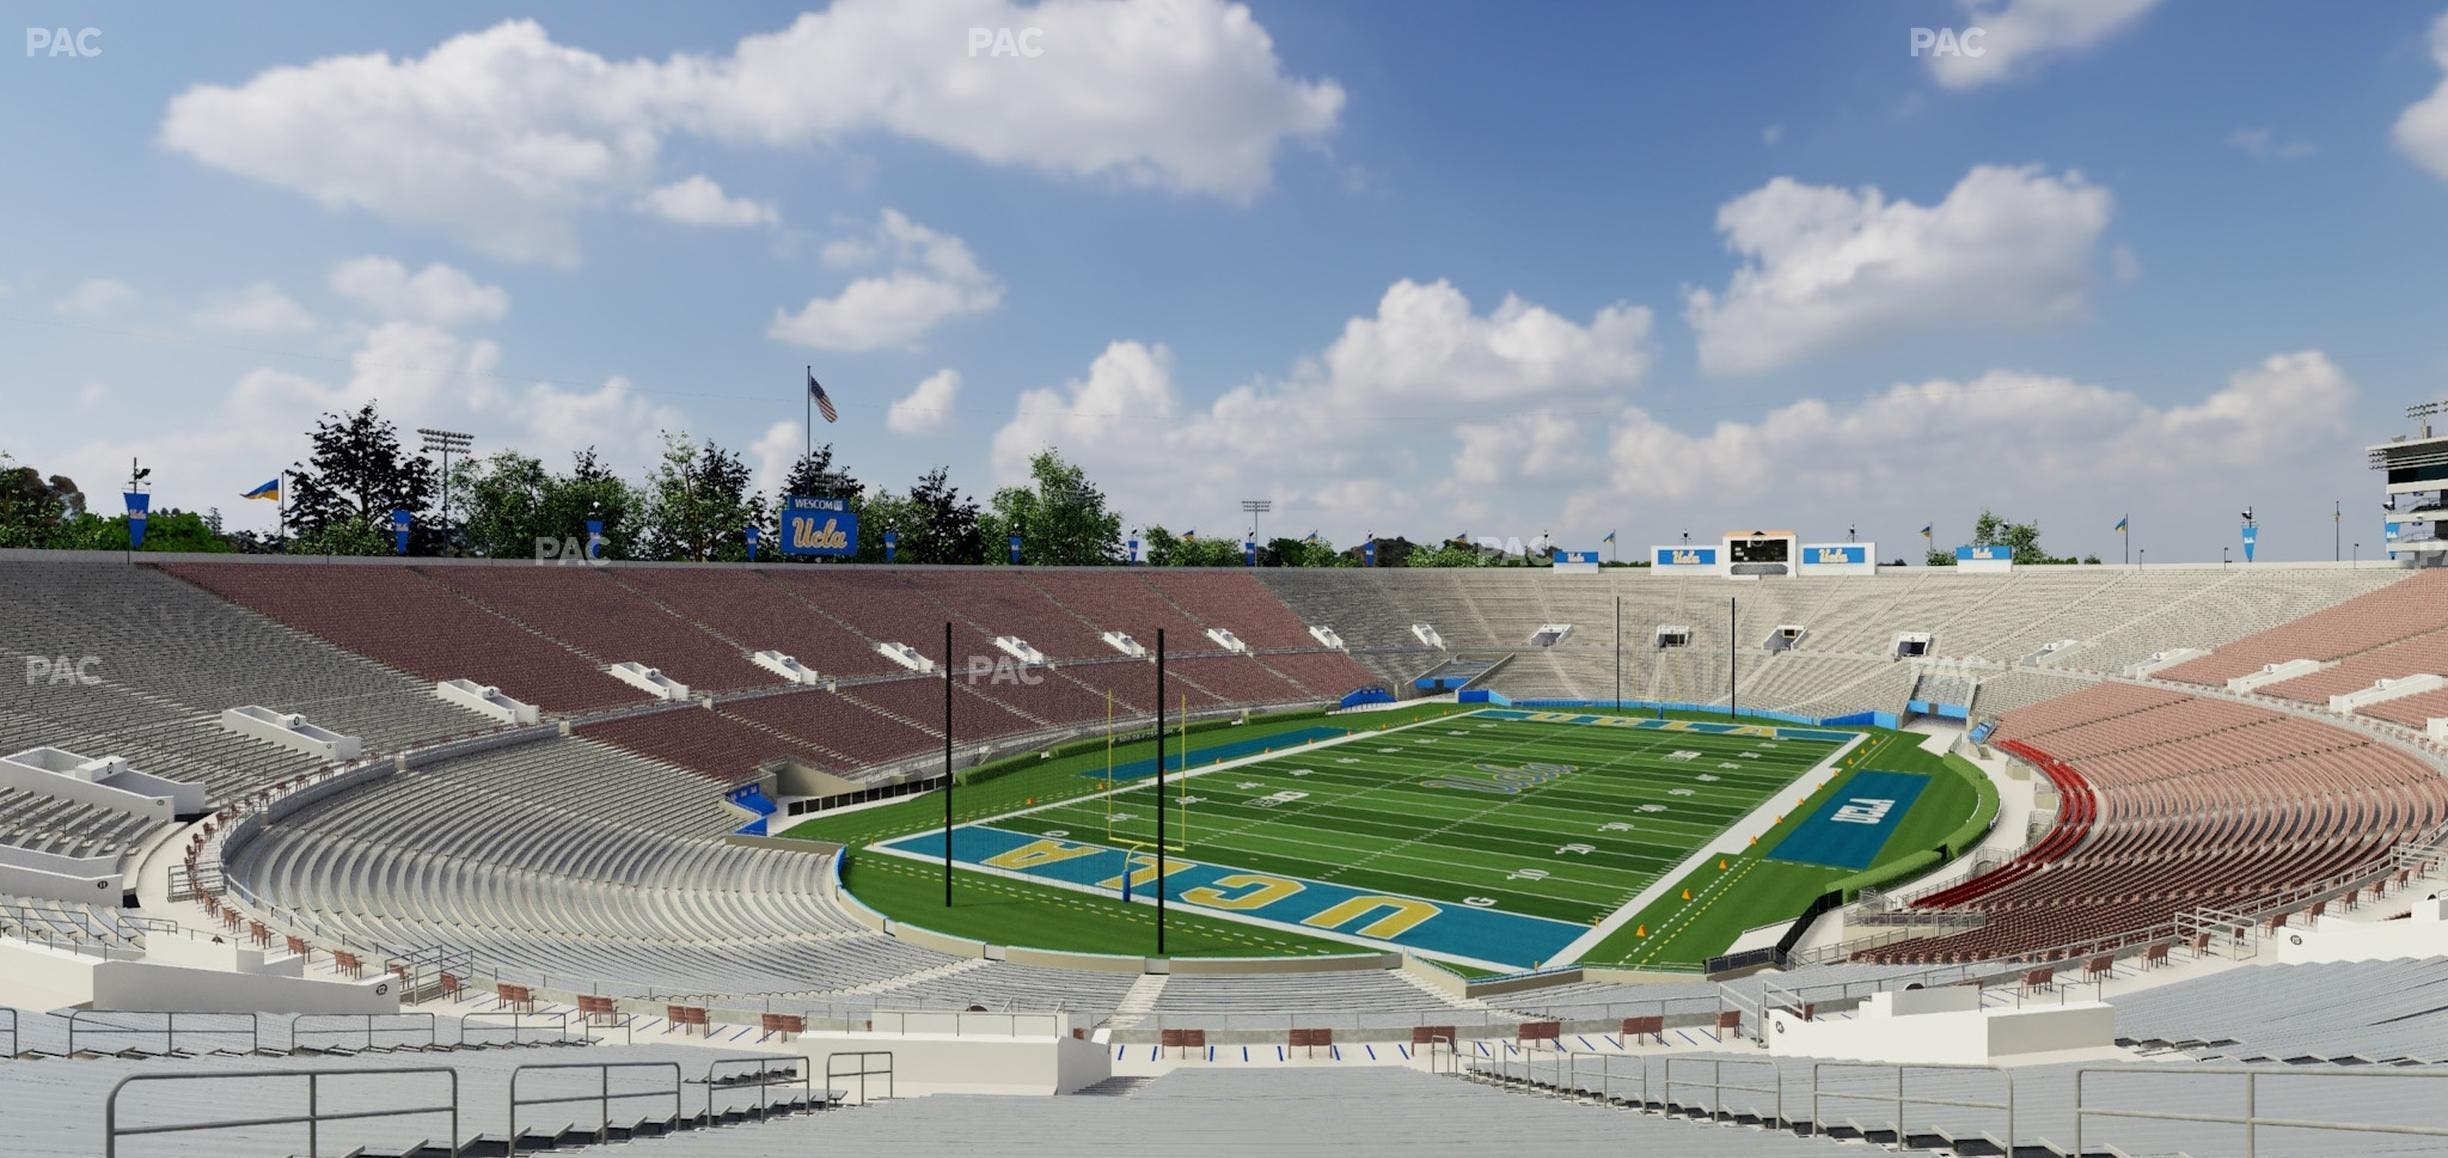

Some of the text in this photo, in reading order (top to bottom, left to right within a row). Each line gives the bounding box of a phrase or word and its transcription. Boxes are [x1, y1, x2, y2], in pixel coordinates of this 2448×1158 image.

[795, 498, 834, 510] WESCOM
[792, 516, 848, 549] Ucla
[980, 839, 1443, 940] UCLA
